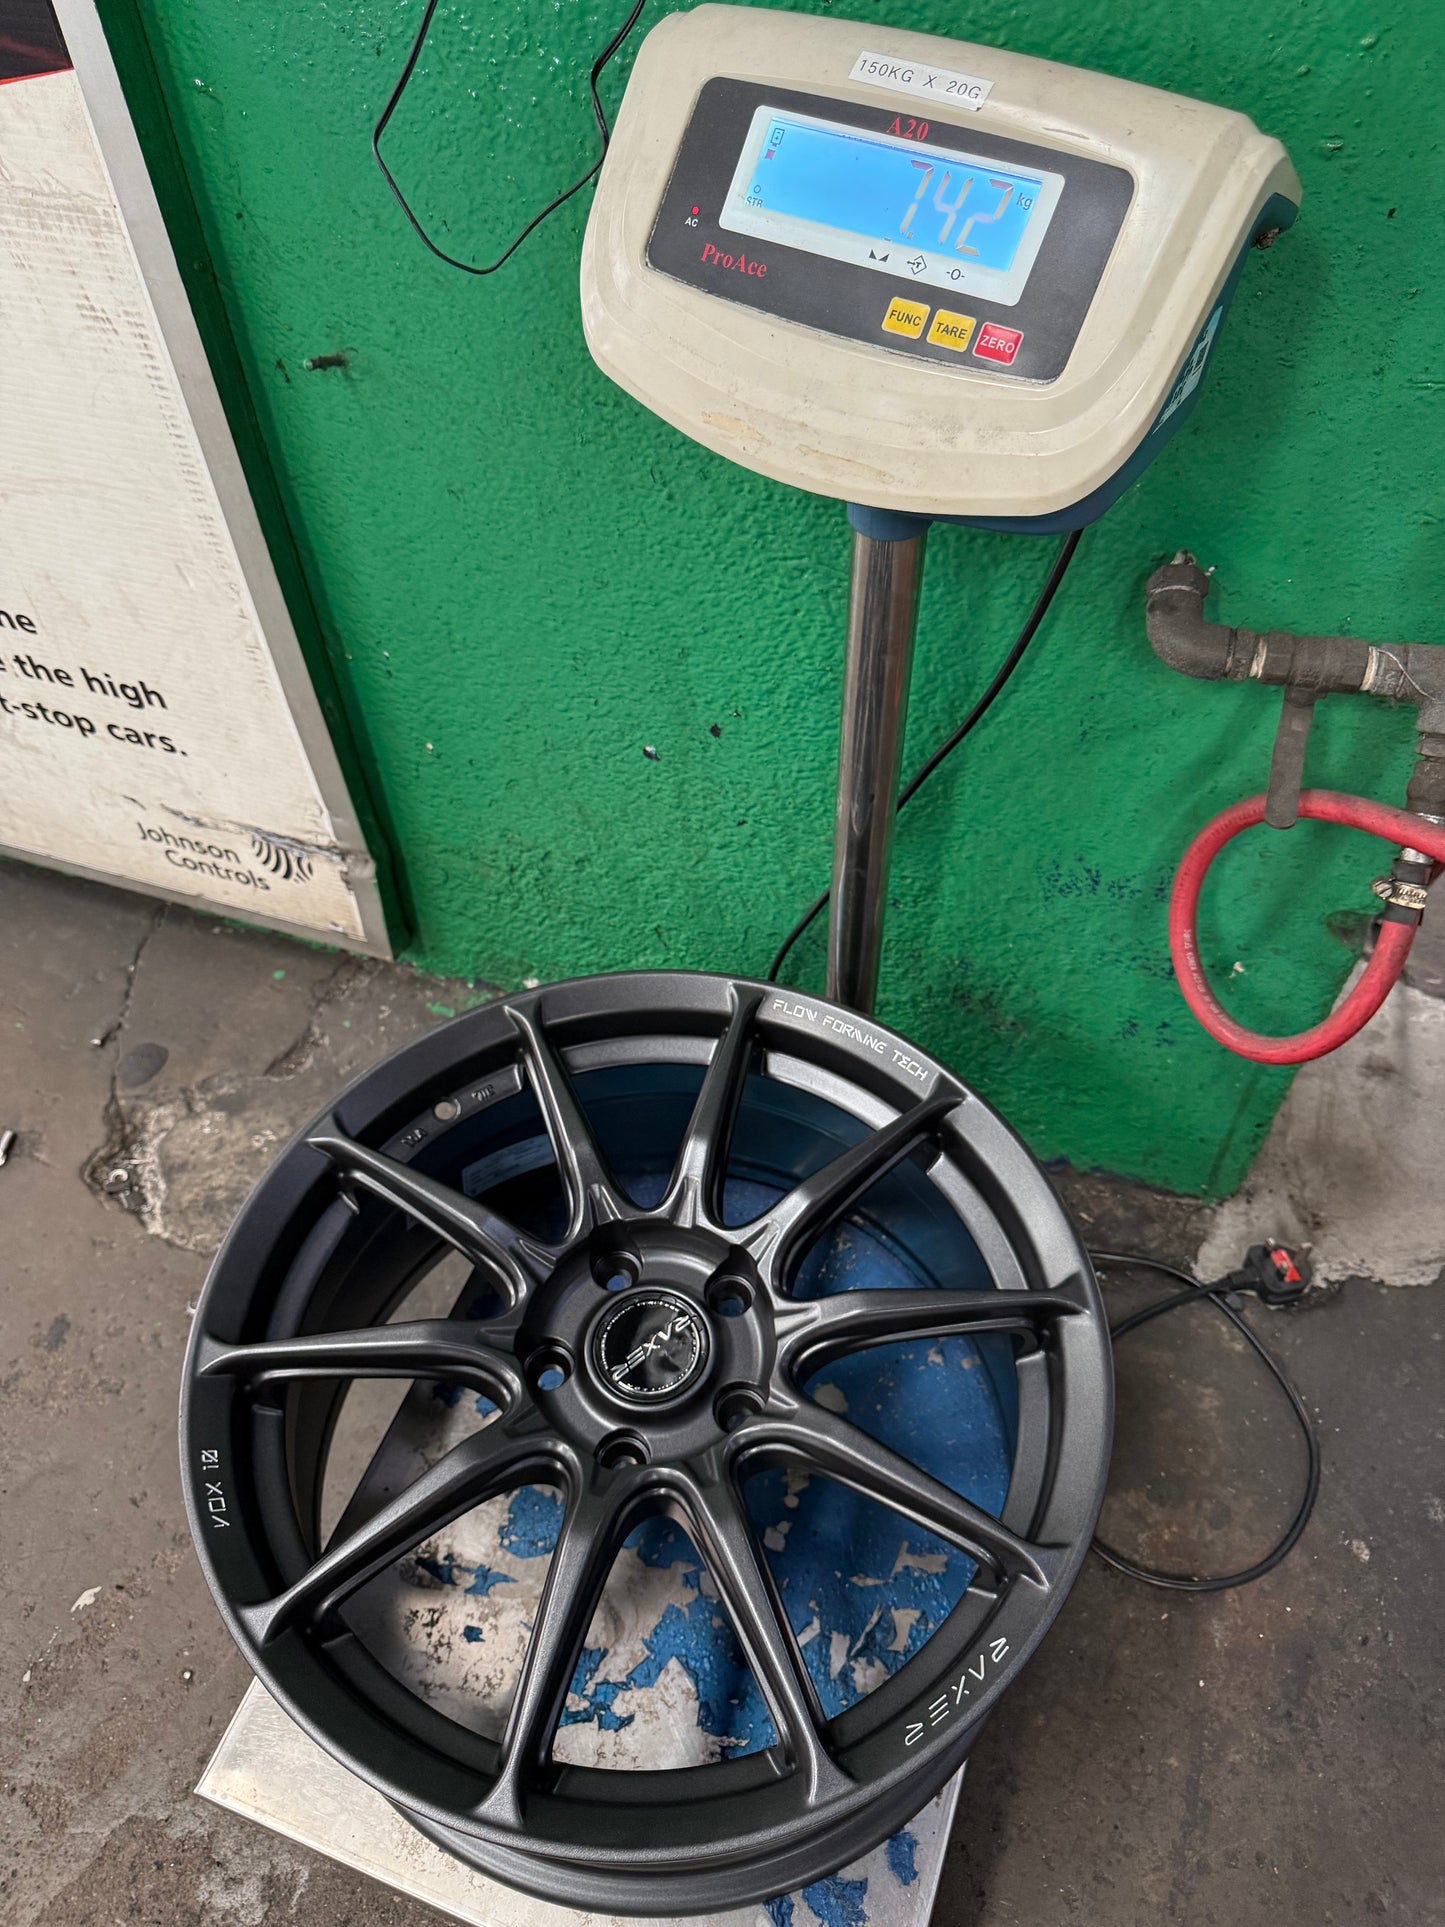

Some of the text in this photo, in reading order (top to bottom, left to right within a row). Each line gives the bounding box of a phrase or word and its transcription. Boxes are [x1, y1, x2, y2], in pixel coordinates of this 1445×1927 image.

[859, 59, 982, 99] 150KG X 20G
[885, 117, 929, 141] A20
[684, 216, 699, 227] AC
[901, 159, 1033, 257] 7.42 kg
[700, 242, 768, 278] ProAce
[889, 309, 922, 327] FUNC
[936, 322, 968, 340] TARE
[980, 335, 1016, 354] ZERO
[13, 654, 75, 688] the
[80, 667, 169, 710] high
[107, 723, 188, 757] cars.
[136, 821, 242, 865] Johnson
[165, 849, 271, 891] Controls
[772, 999, 929, 1081] FLOW FORMING TECH
[905, 1637, 1010, 1746] RAXER
